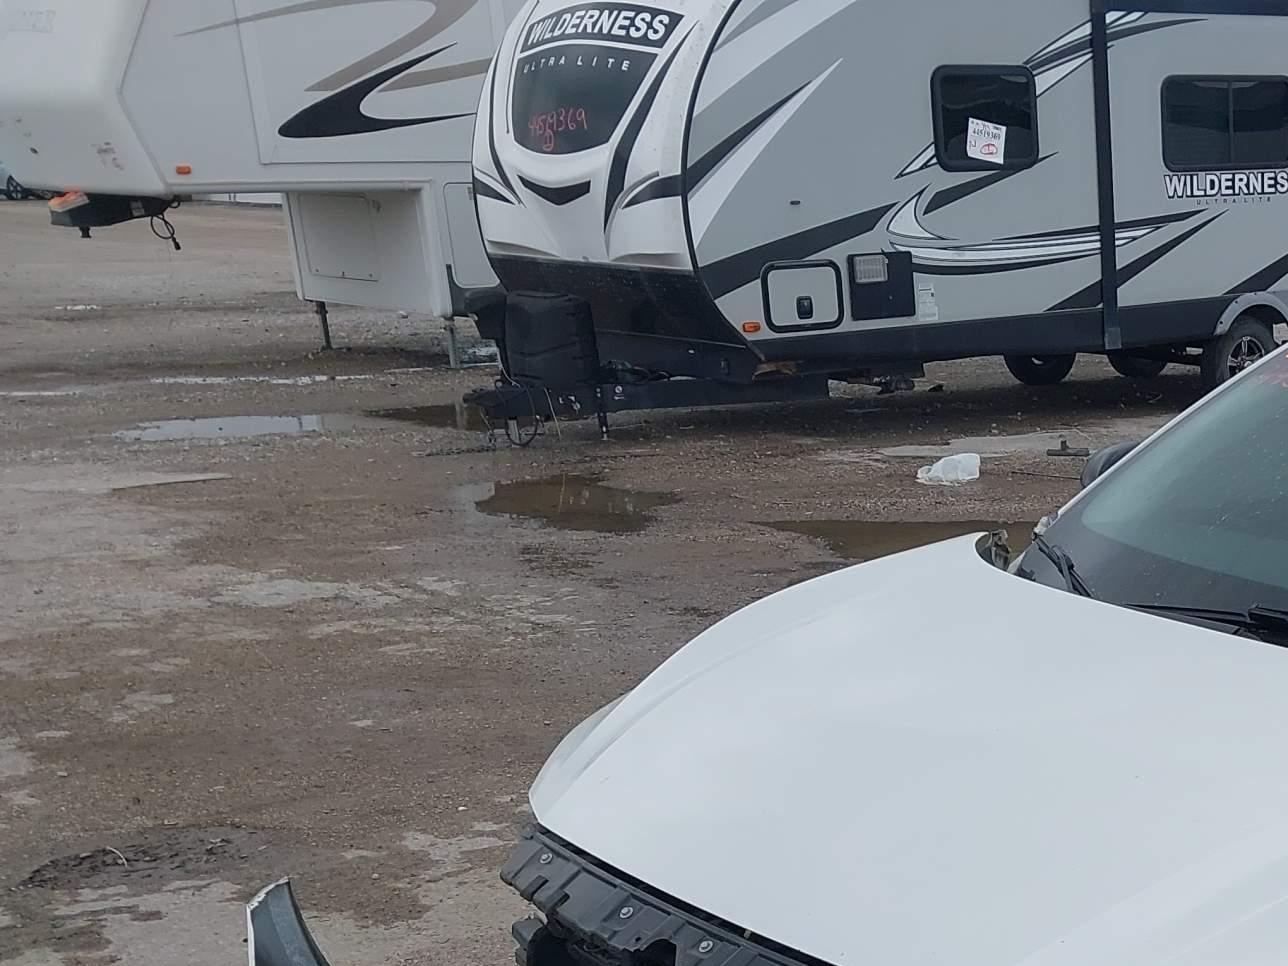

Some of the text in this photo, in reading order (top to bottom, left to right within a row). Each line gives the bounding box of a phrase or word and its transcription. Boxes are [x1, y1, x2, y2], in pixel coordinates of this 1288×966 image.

[527, 9, 670, 46] WILDERNESS
[523, 55, 631, 74] ULTRA LITE
